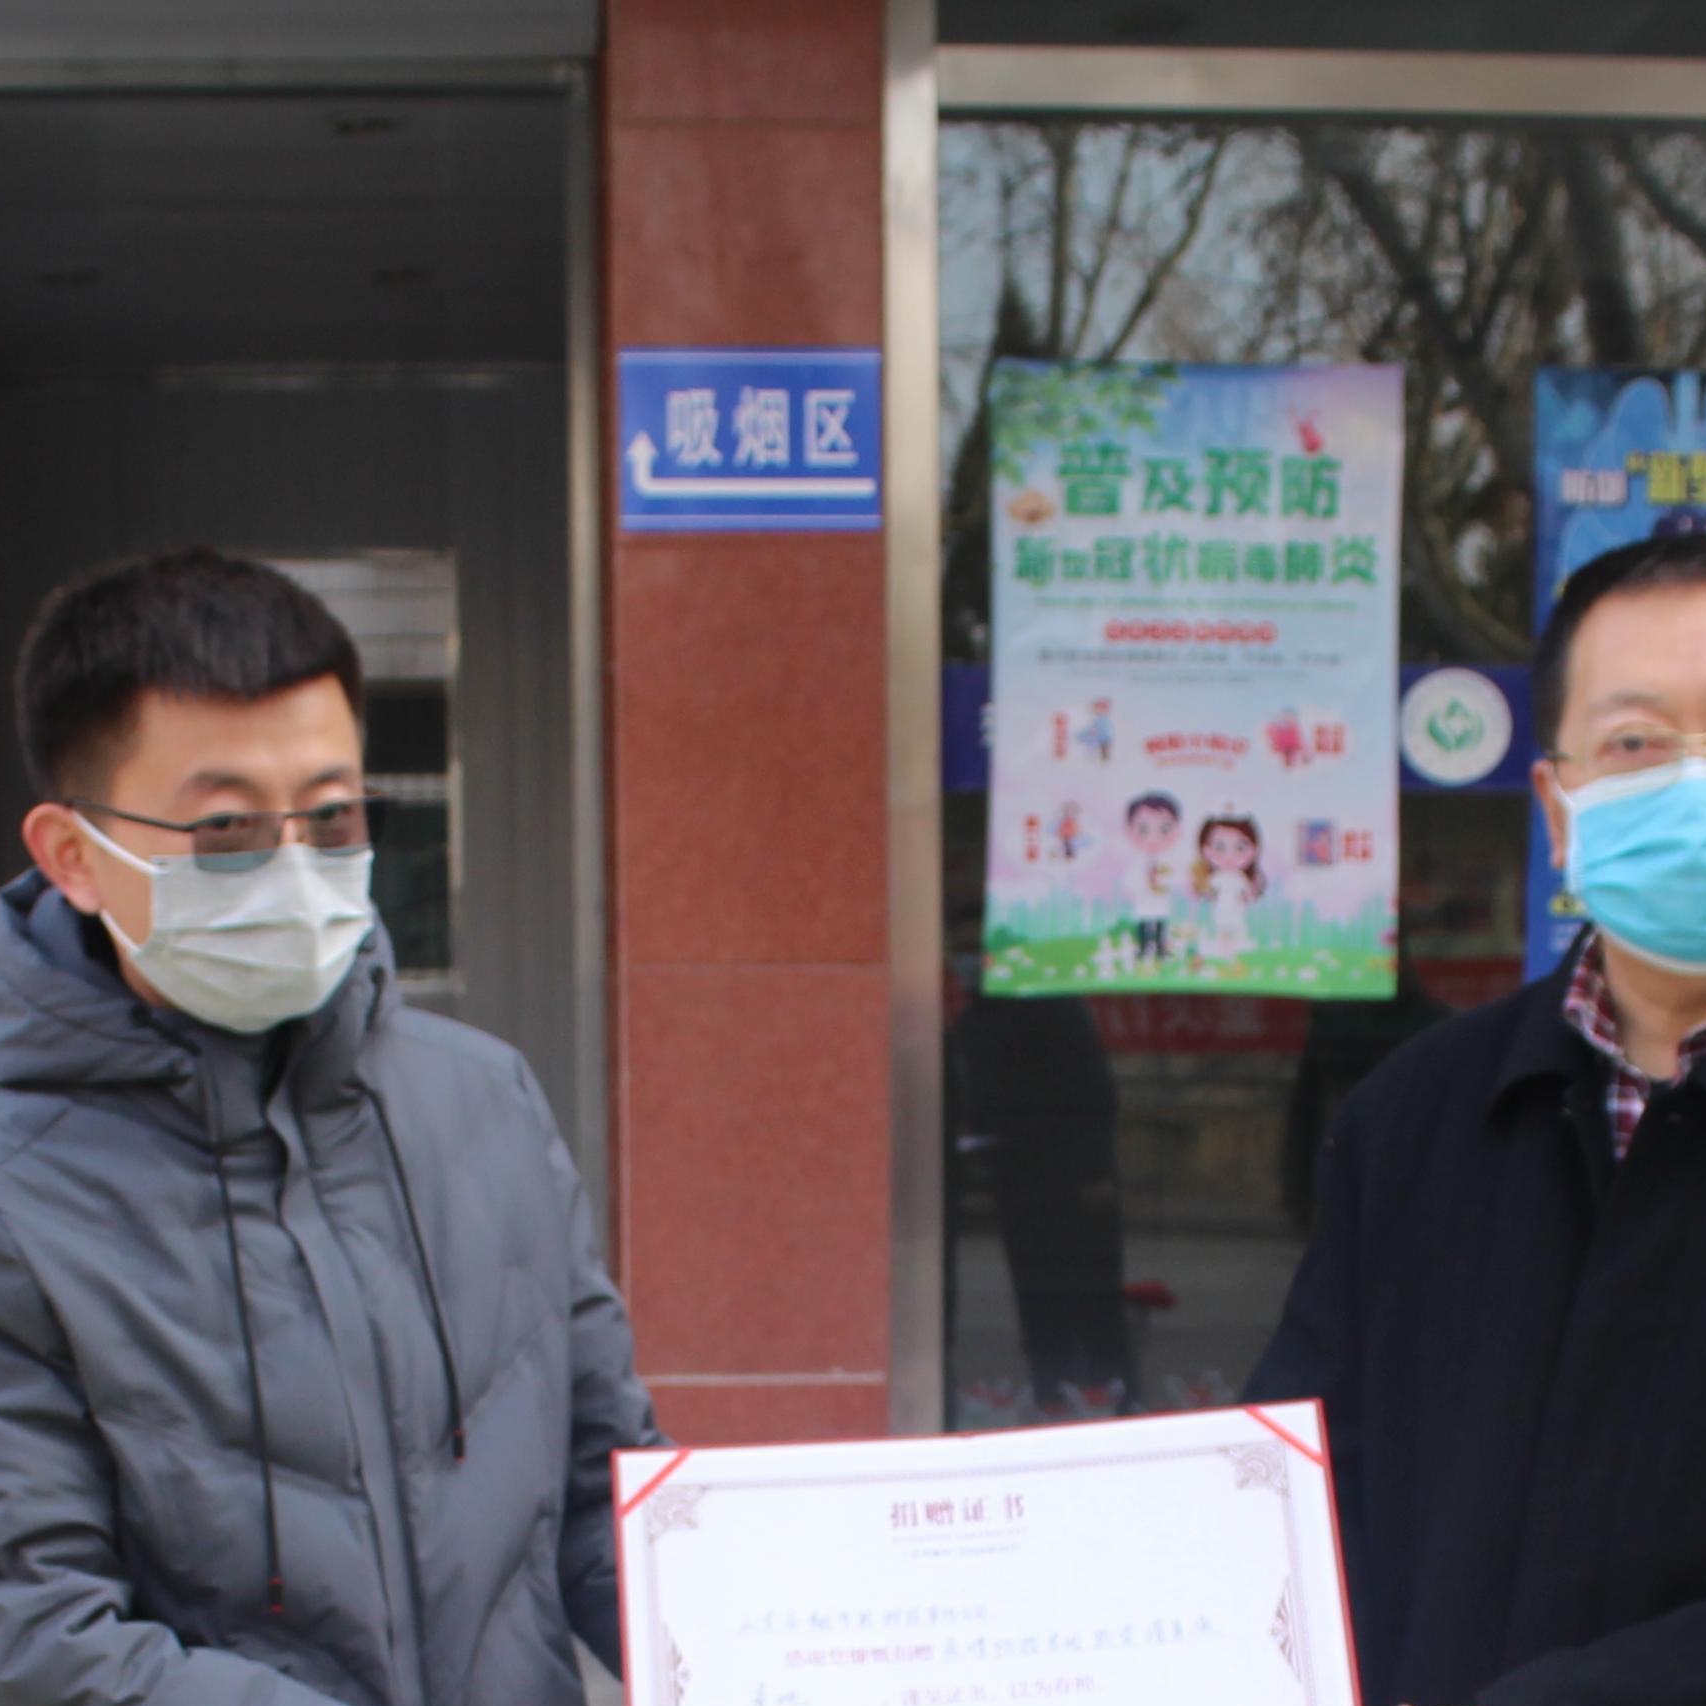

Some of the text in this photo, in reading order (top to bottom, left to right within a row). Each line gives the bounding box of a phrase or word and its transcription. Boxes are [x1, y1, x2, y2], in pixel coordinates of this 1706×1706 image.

[666, 388, 858, 467] 吸烟区
[1057, 441, 1342, 518] 普及预防
[1014, 531, 1378, 587] 新型冠状病毒肺炎
[890, 1494, 1024, 1528] 捐赠证书
